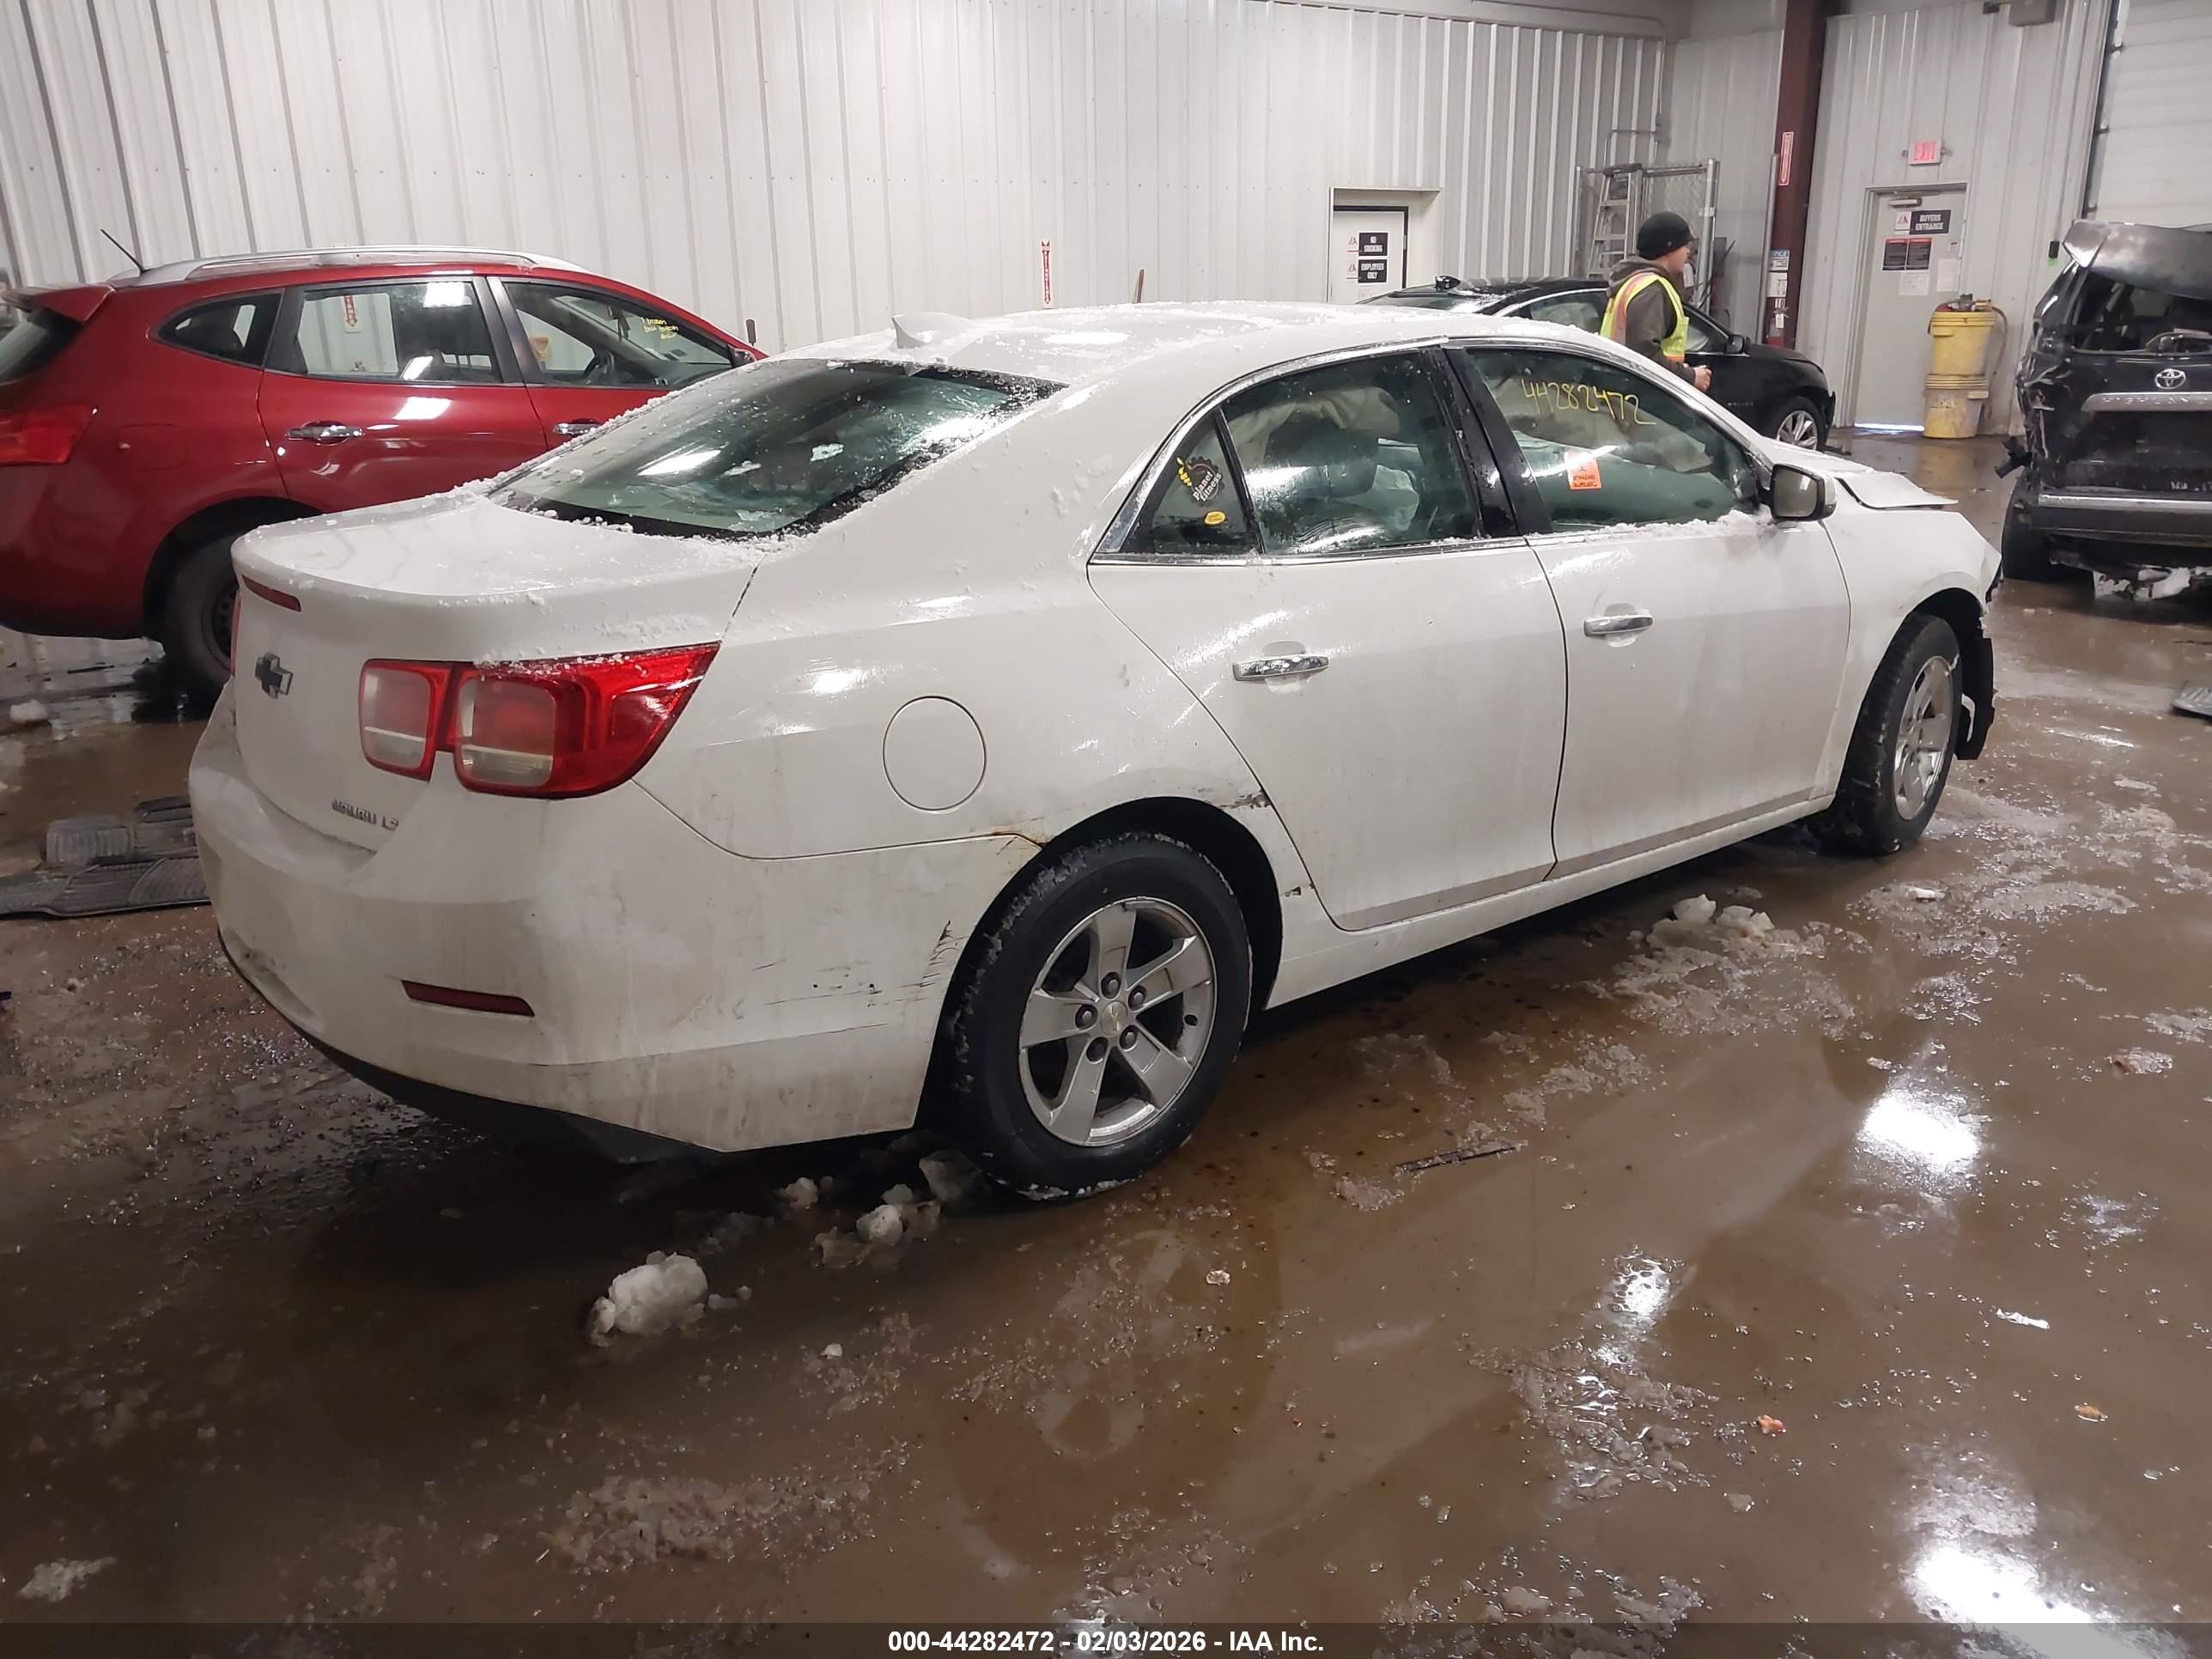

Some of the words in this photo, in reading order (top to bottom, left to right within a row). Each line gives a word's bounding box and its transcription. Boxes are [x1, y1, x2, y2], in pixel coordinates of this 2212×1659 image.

[1912, 141, 1937, 161] EXIT
[1915, 222, 1944, 231] ENTRANCE
[1521, 379, 1656, 425] 44282472
[1193, 471, 1213, 501] planet
[1200, 473, 1222, 501] fitness
